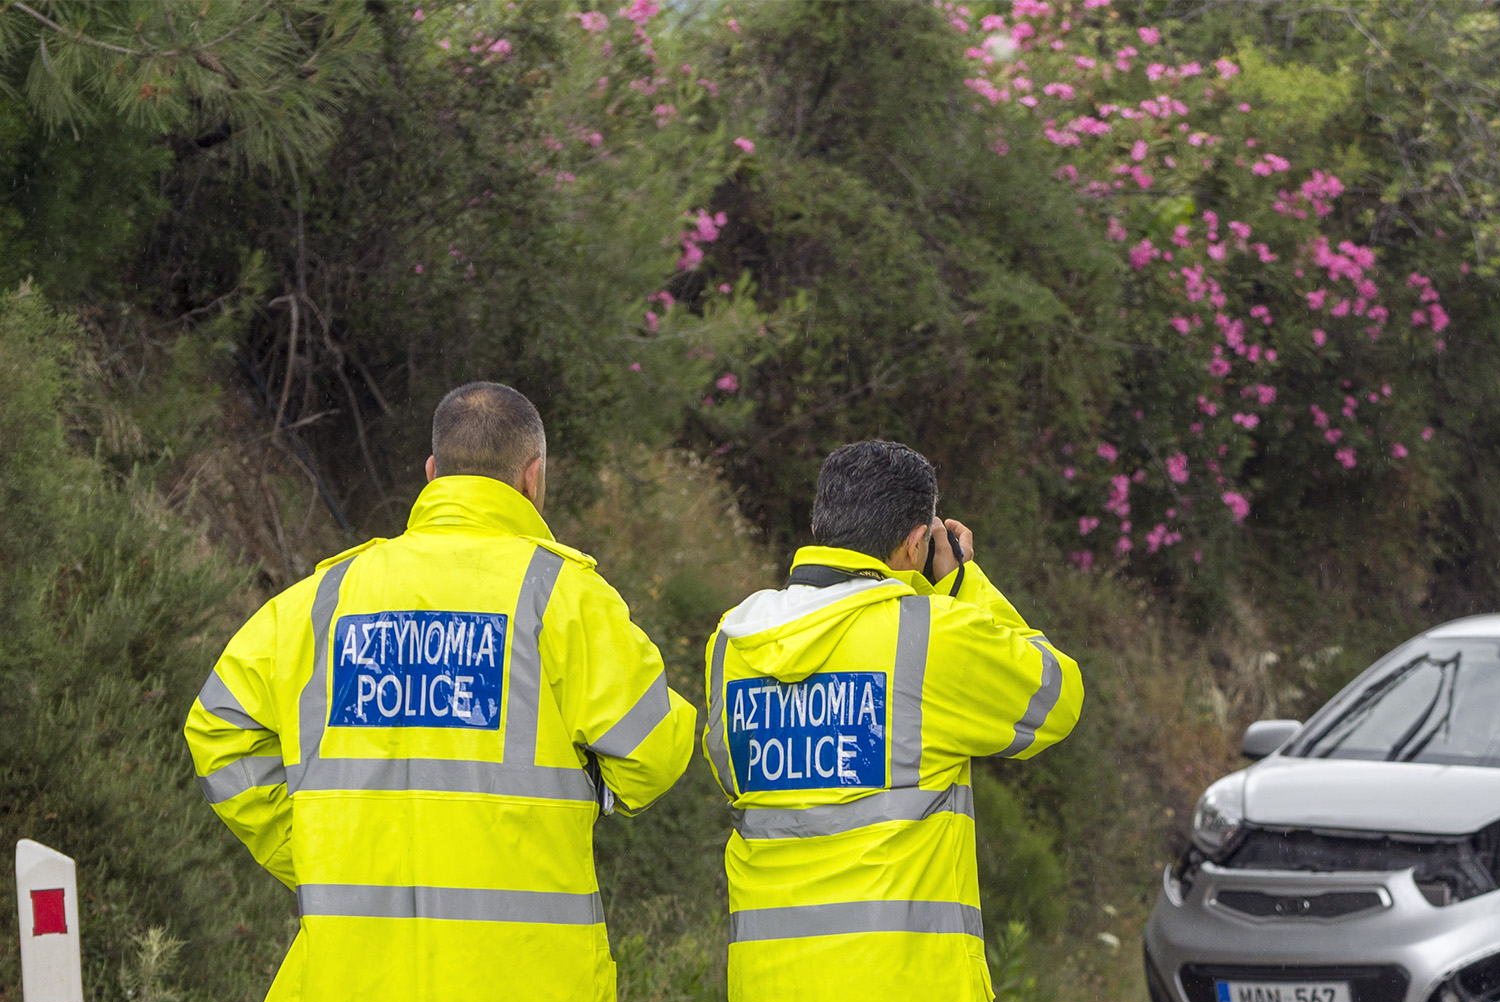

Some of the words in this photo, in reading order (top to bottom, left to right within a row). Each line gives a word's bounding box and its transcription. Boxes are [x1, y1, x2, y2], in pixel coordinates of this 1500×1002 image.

[340, 620, 495, 668] ΑΣΤΥΝΟΜΙΑ
[357, 674, 474, 718] POLICE
[733, 681, 877, 732] ΑΣΤΥΝΟΜΙΑ
[748, 735, 857, 781] POLICE
